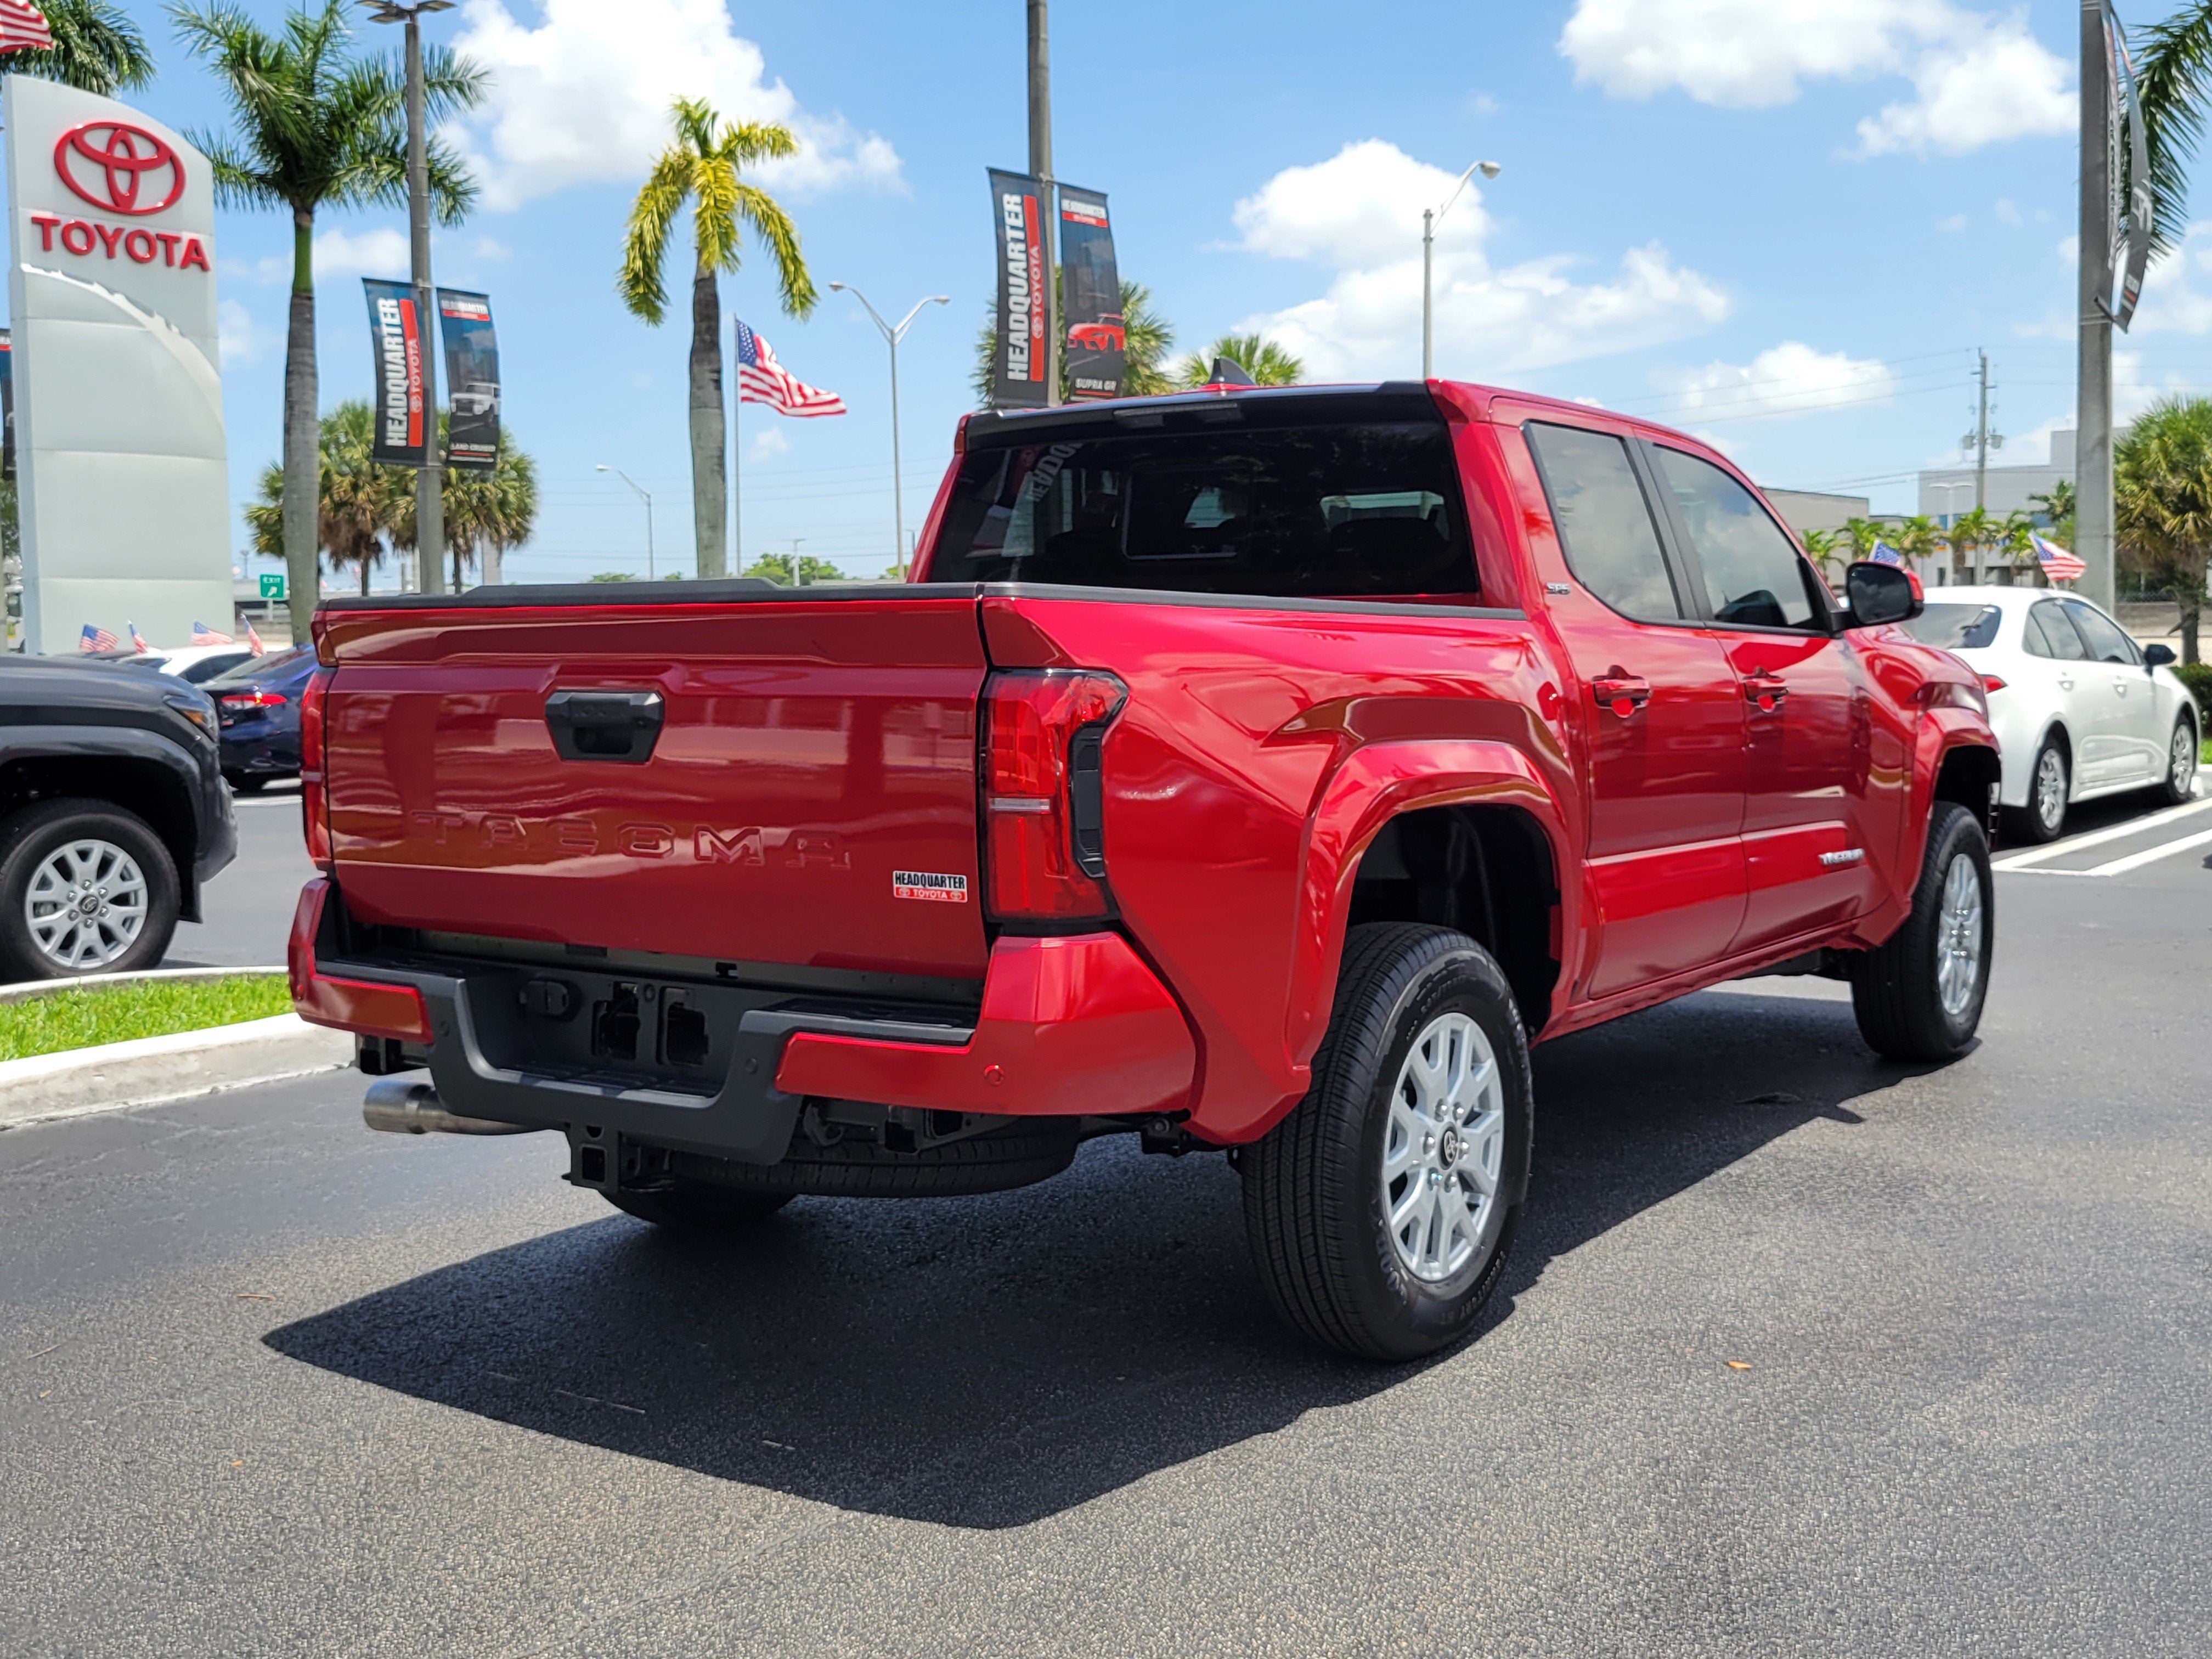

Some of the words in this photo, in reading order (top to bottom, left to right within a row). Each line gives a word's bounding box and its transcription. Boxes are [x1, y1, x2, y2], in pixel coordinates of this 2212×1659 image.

[31, 216, 211, 272] TOYOTA
[1002, 192, 1031, 381] HEADQUARTER
[1029, 245, 1043, 311] TOYOTA
[376, 297, 409, 447] HEADQUARTER
[408, 338, 420, 393] TOYOTA
[410, 810, 851, 870] TACOMA
[895, 872, 965, 889] HEADQUARTER
[913, 889, 947, 899] TOYOTA
